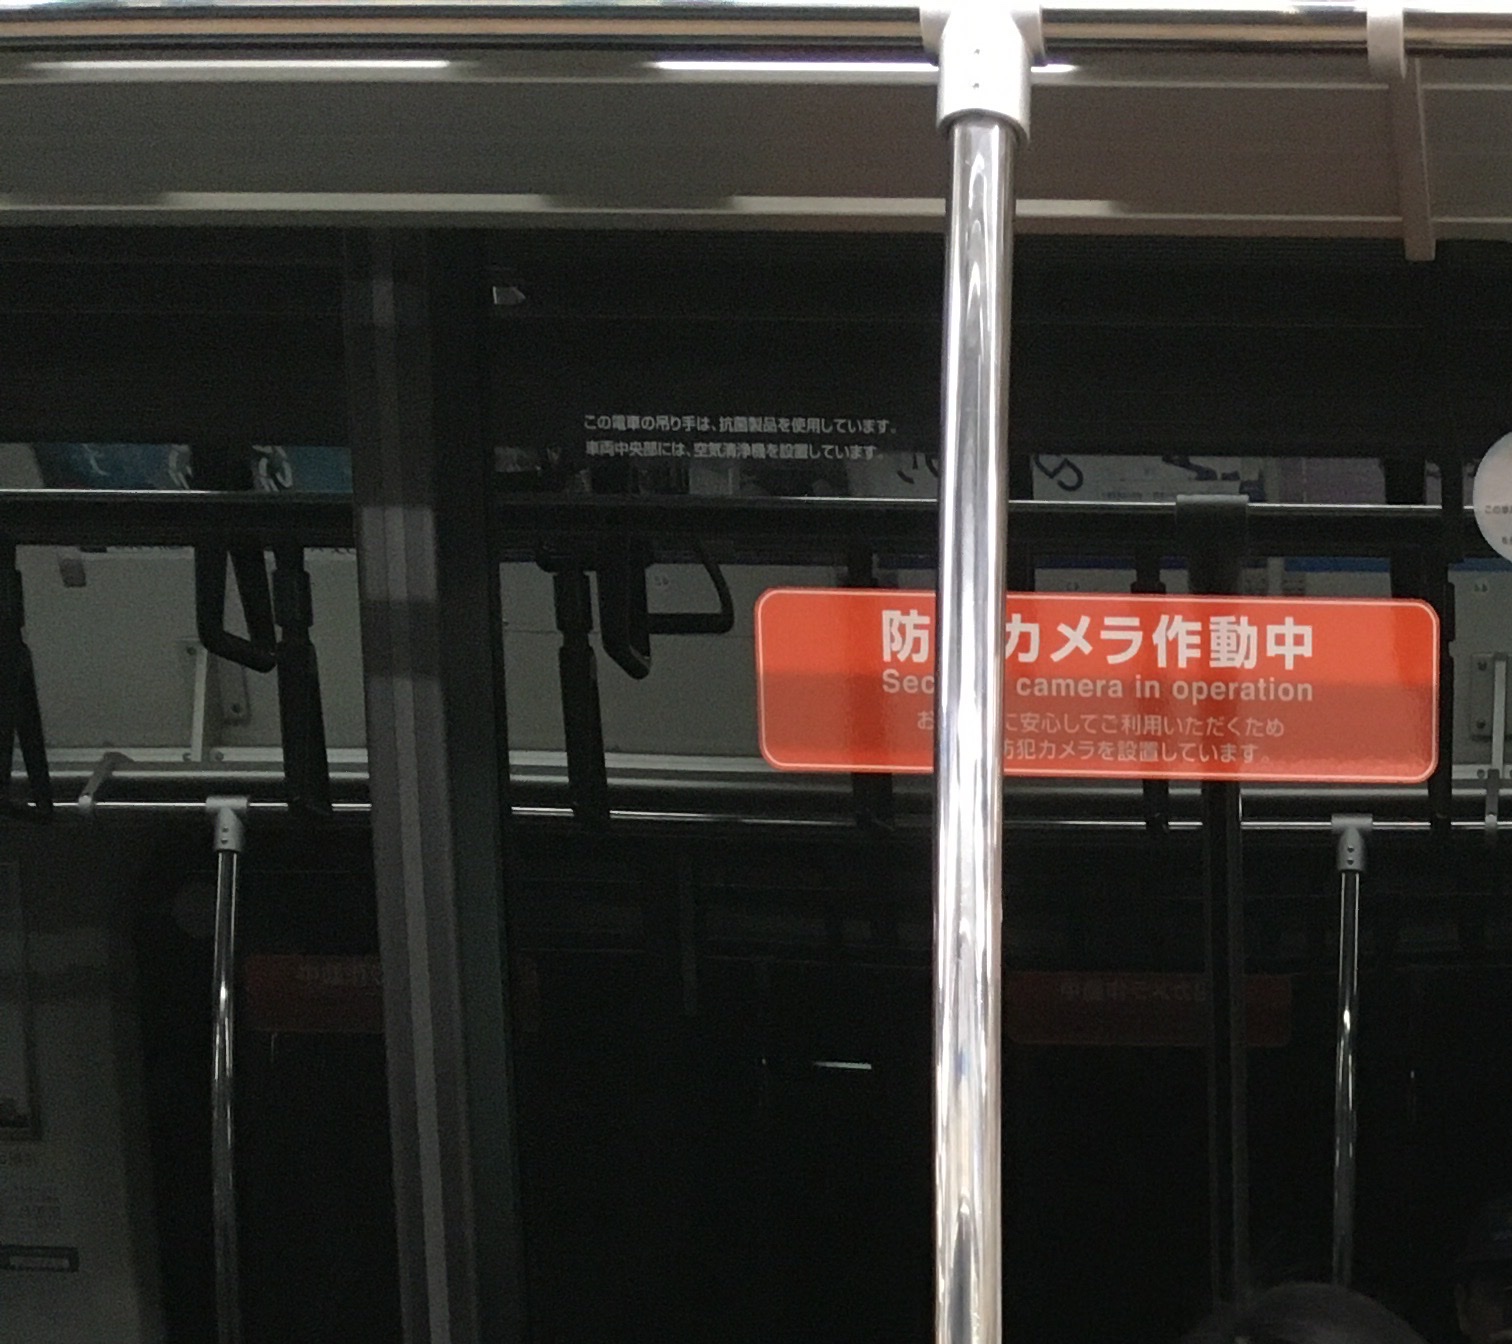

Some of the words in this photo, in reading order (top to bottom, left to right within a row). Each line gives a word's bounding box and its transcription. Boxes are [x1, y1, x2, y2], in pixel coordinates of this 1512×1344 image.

[882, 609, 1313, 671] 防カメラ作動中
[1016, 676, 1123, 699] camera
[1134, 674, 1161, 698] in
[1172, 677, 1313, 705] operation
[917, 711, 1284, 737] おに安心してご利用いただくため
